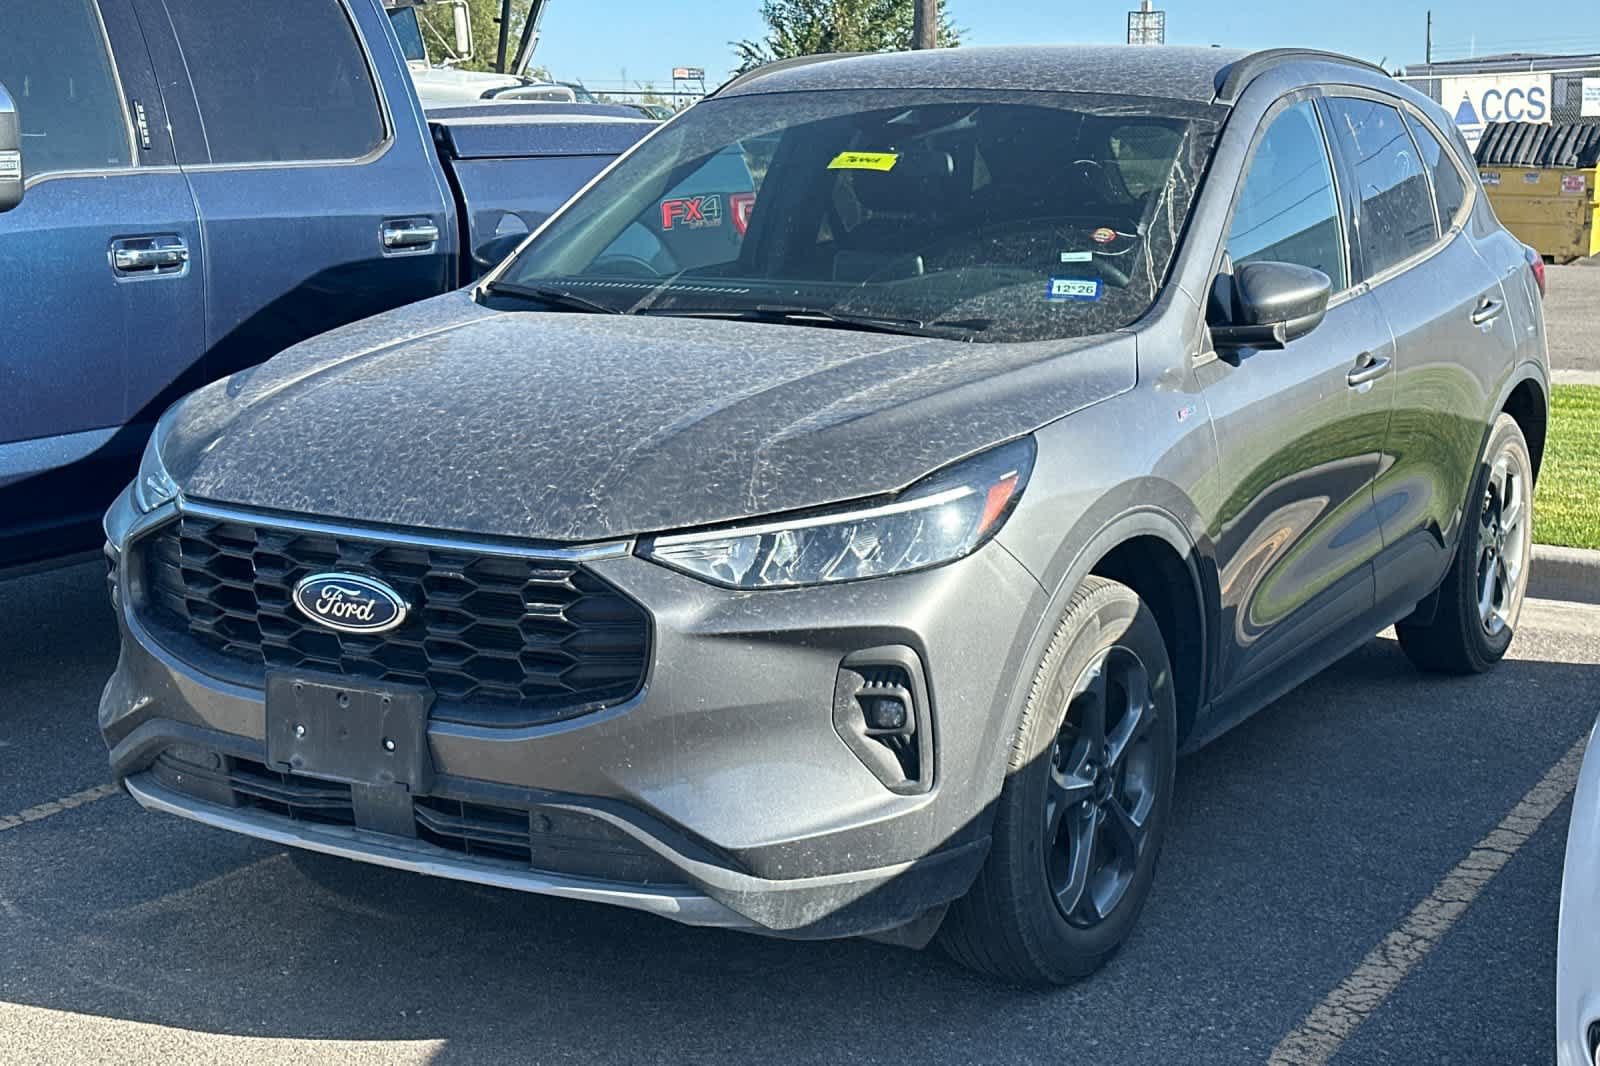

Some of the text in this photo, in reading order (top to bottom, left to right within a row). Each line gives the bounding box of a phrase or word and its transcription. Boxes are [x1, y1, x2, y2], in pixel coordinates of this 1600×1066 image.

[1481, 86, 1546, 120] CCS
[661, 195, 721, 230] FX4
[316, 585, 376, 621] Ford
